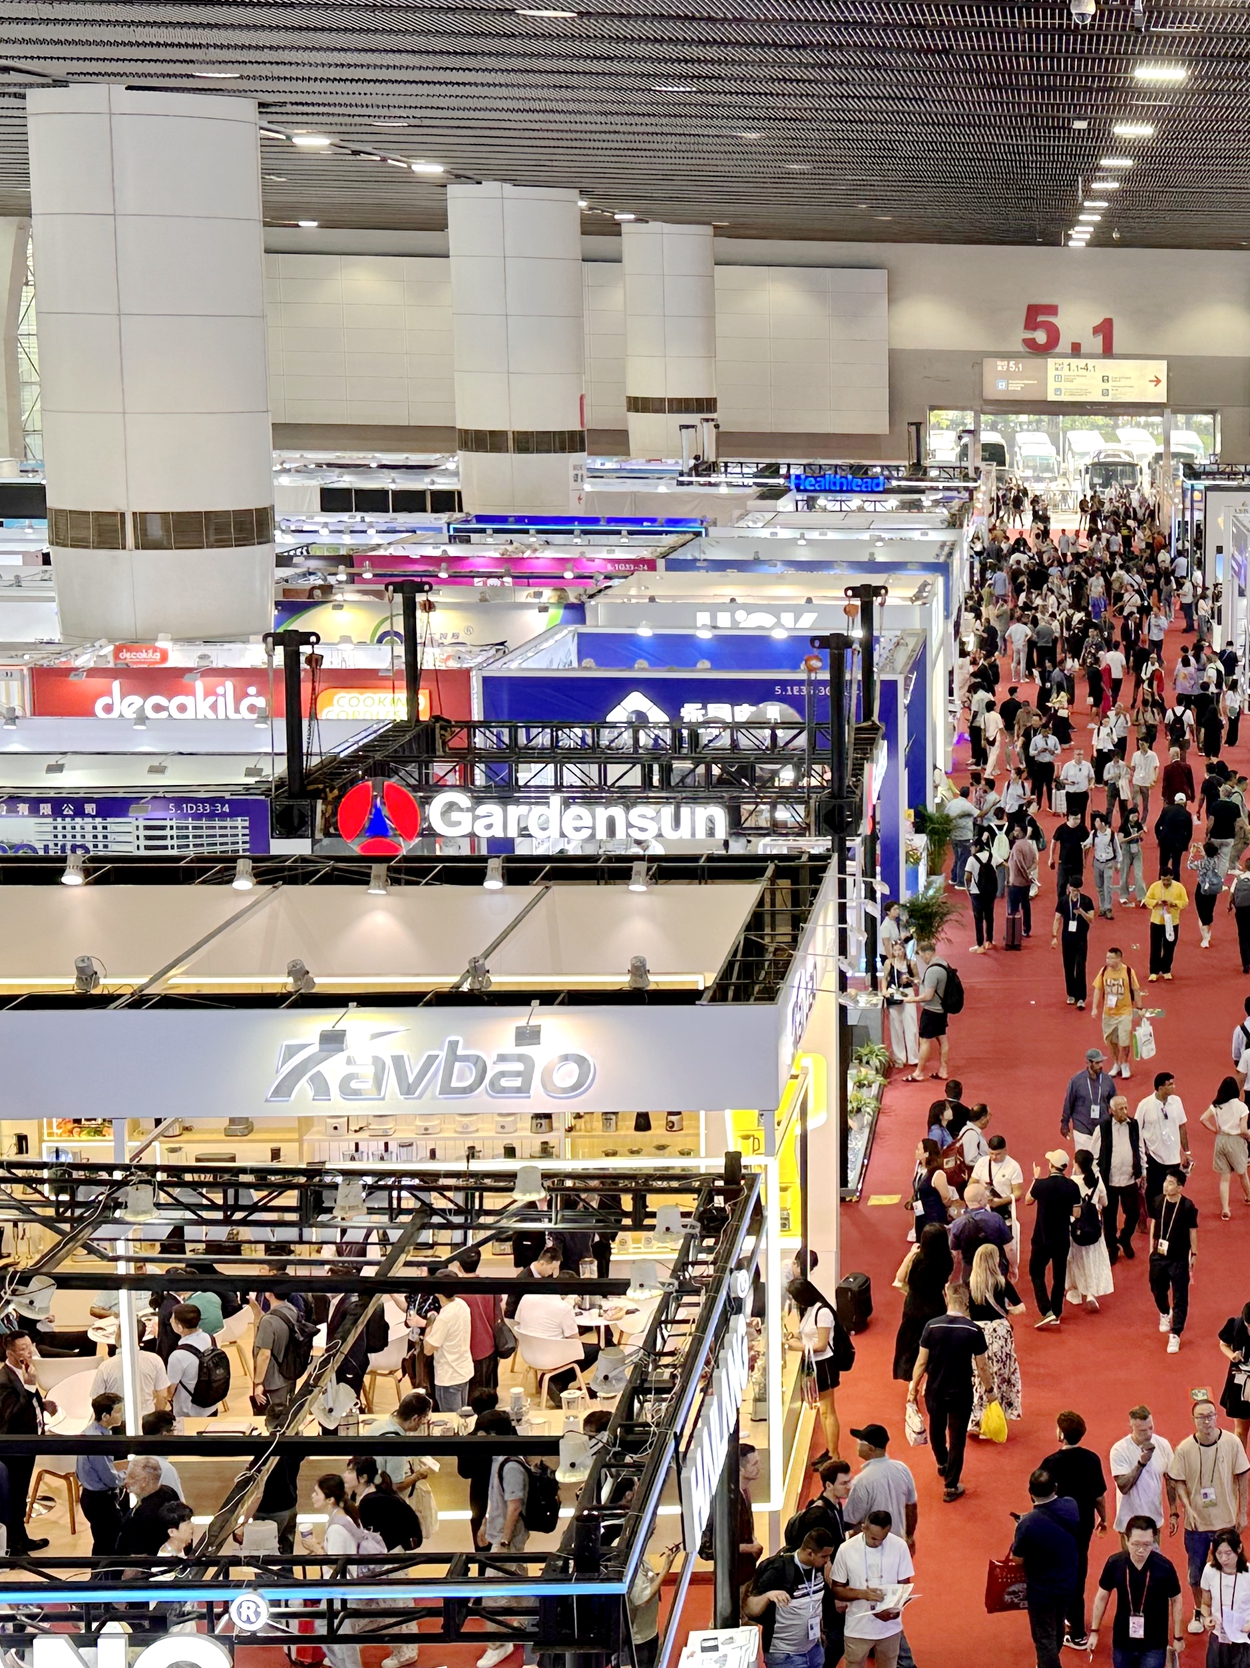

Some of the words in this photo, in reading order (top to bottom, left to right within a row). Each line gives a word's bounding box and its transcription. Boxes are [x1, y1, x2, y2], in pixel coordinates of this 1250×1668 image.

[1021, 303, 1114, 357] 5.1
[789, 473, 885, 493] Healthlead
[168, 802, 230, 815] 5.1D33-34
[428, 790, 728, 841] Gardensun
[265, 1033, 597, 1102] Kavbao
